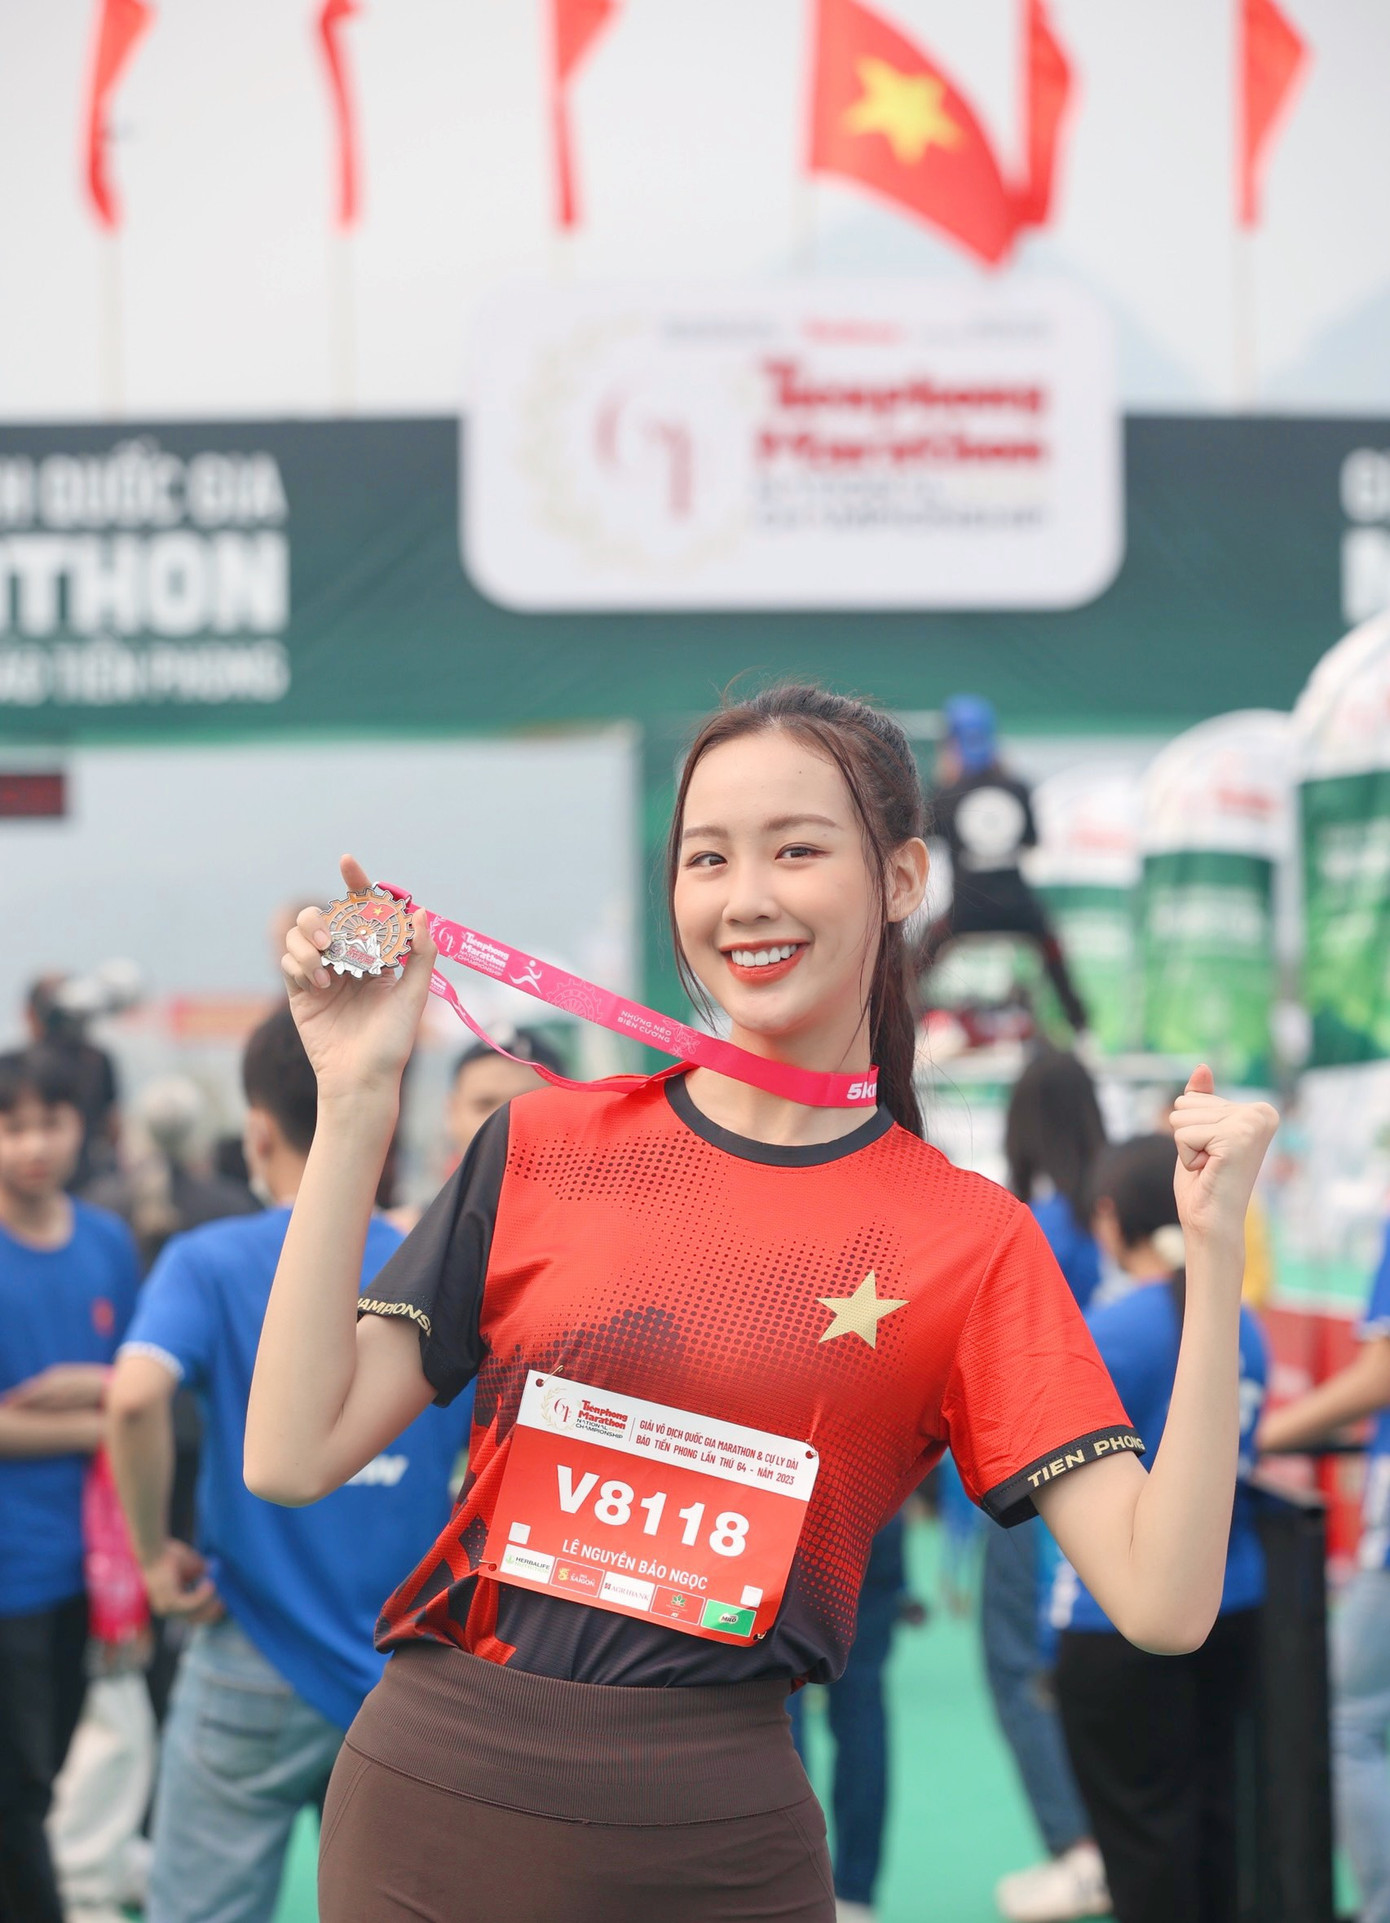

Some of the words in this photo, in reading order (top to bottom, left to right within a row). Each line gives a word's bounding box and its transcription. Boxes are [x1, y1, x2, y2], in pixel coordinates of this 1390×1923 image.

[0, 530, 290, 636] THON
[461, 942, 507, 968] Marathon
[575, 1423, 624, 1439] CHAMPIONSHIP
[576, 1418, 608, 1431] NATIONAL
[577, 1410, 627, 1430] Marathon
[673, 1444, 698, 1460] PHONG
[736, 1461, 747, 1473] 64
[775, 1472, 795, 1486] 2023
[704, 1437, 716, 1448] GIA
[717, 1441, 756, 1459] MARATHON
[756, 1451, 763, 1461] &
[775, 1455, 786, 1467] LY
[1027, 1449, 1086, 1487] TIEN
[556, 1464, 750, 1557] V8118
[515, 1556, 551, 1571] HERBALIFE
[562, 1538, 580, 1555] LÊ
[580, 1543, 636, 1571] NGUYỄN
[637, 1559, 667, 1579] BẢO
[668, 1567, 708, 1590] NGỌC
[611, 1585, 650, 1601] AGRIBANK
